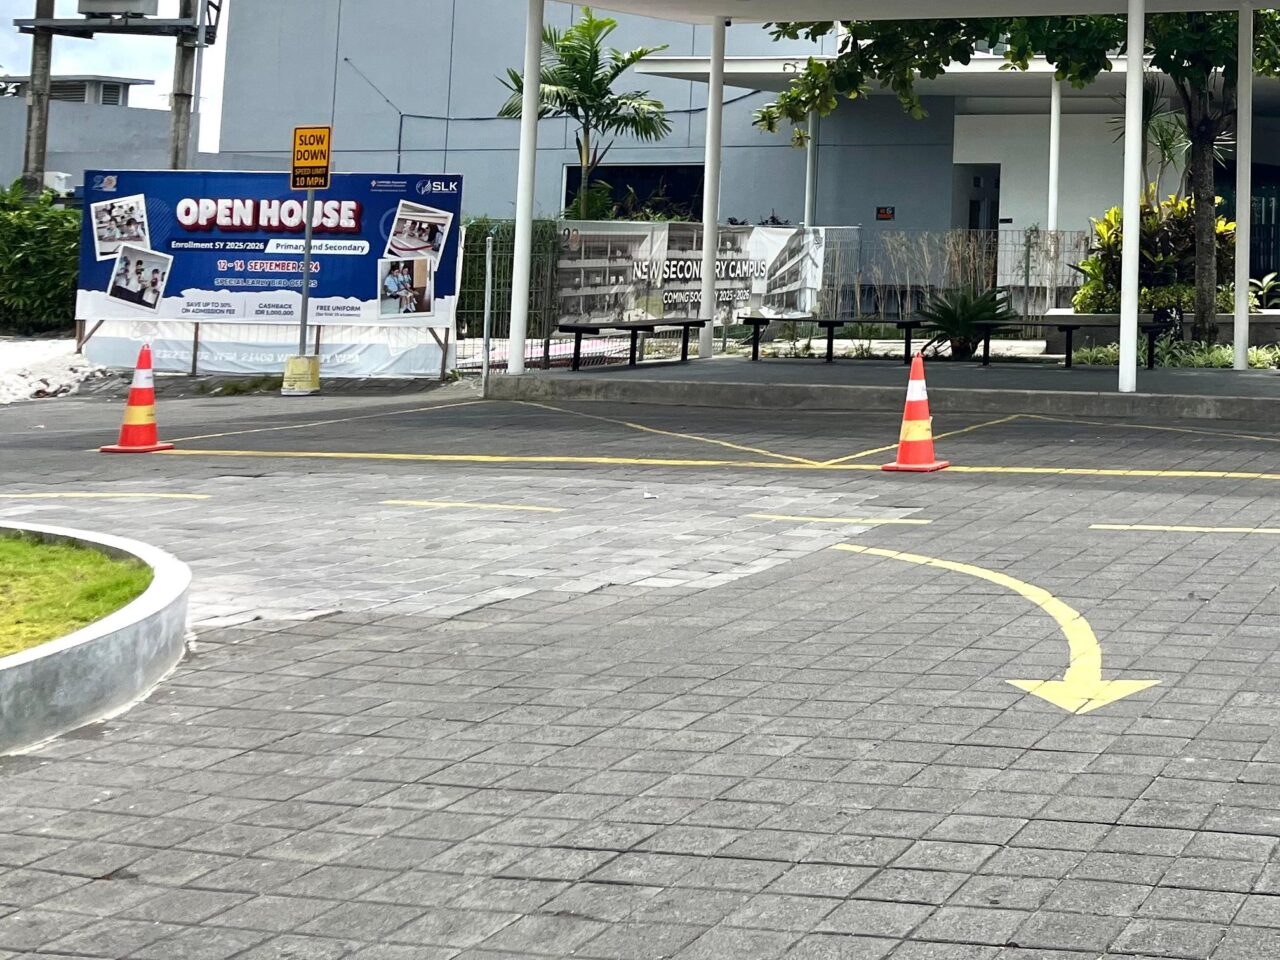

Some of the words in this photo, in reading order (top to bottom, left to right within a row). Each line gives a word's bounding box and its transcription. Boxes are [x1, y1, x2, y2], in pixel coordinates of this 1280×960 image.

[298, 134, 326, 146] SLOW
[295, 149, 327, 161] DOWN
[295, 167, 310, 175] SPEED
[311, 167, 326, 175] LIMIT
[296, 177, 305, 186] 10
[306, 176, 325, 186] MPH
[432, 181, 458, 191] SLK
[176, 198, 255, 228] OPEN
[258, 199, 358, 230] HOUSE
[171, 240, 213, 249] Enrollment
[214, 241, 225, 249] SY
[225, 241, 265, 250] 2025/2026
[275, 242, 306, 252] Primary
[324, 243, 365, 253] Secondary
[247, 260, 298, 273] SEPTEMBER
[298, 261, 320, 273] 224
[632, 261, 661, 280] NEW
[728, 260, 766, 278] CAMPUS
[214, 277, 244, 286] SPECIAL
[289, 278, 318, 288] OFFRS
[662, 291, 690, 304] COMING
[719, 290, 733, 301] 2025
[736, 289, 750, 300] 2026
